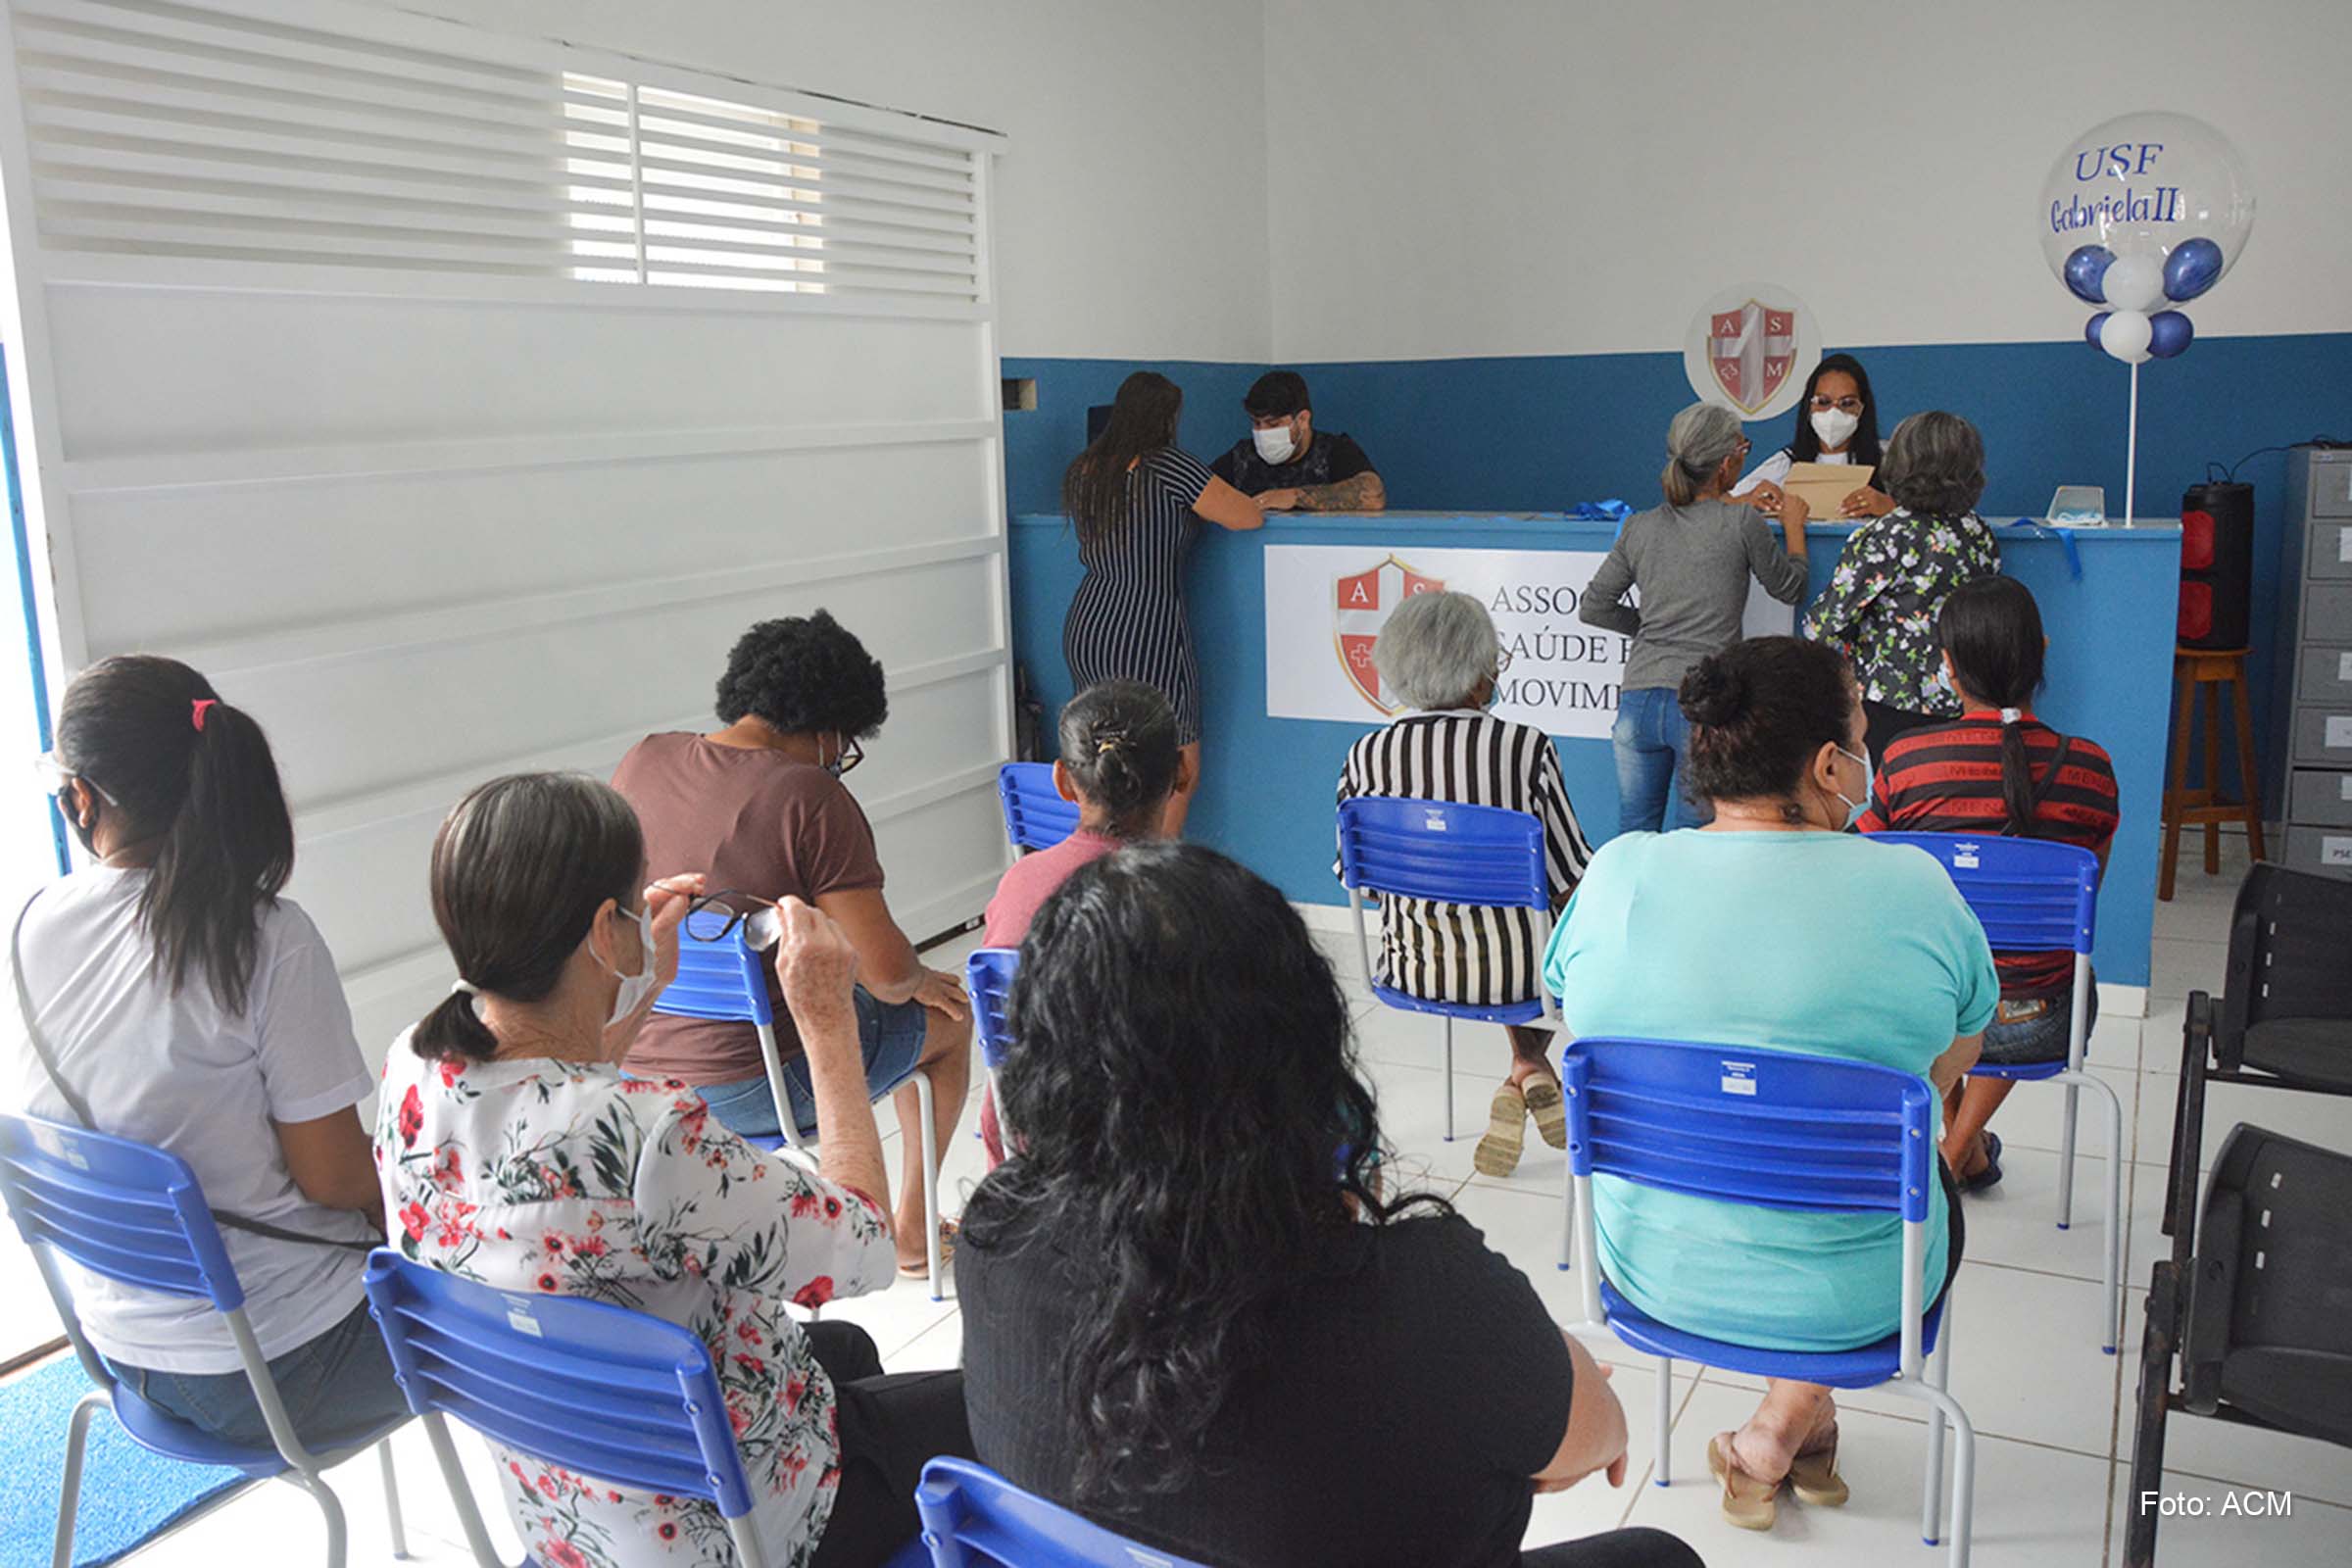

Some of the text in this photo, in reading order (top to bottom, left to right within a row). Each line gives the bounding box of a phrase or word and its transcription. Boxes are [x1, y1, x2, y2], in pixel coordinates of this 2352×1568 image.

[2076, 144, 2163, 181] USF
[2051, 187, 2149, 233] Gabriela
[1720, 317, 1782, 333] A S
[1766, 362, 1783, 377] M
[1349, 580, 1369, 603] A
[1495, 678, 1621, 711] MOVIM
